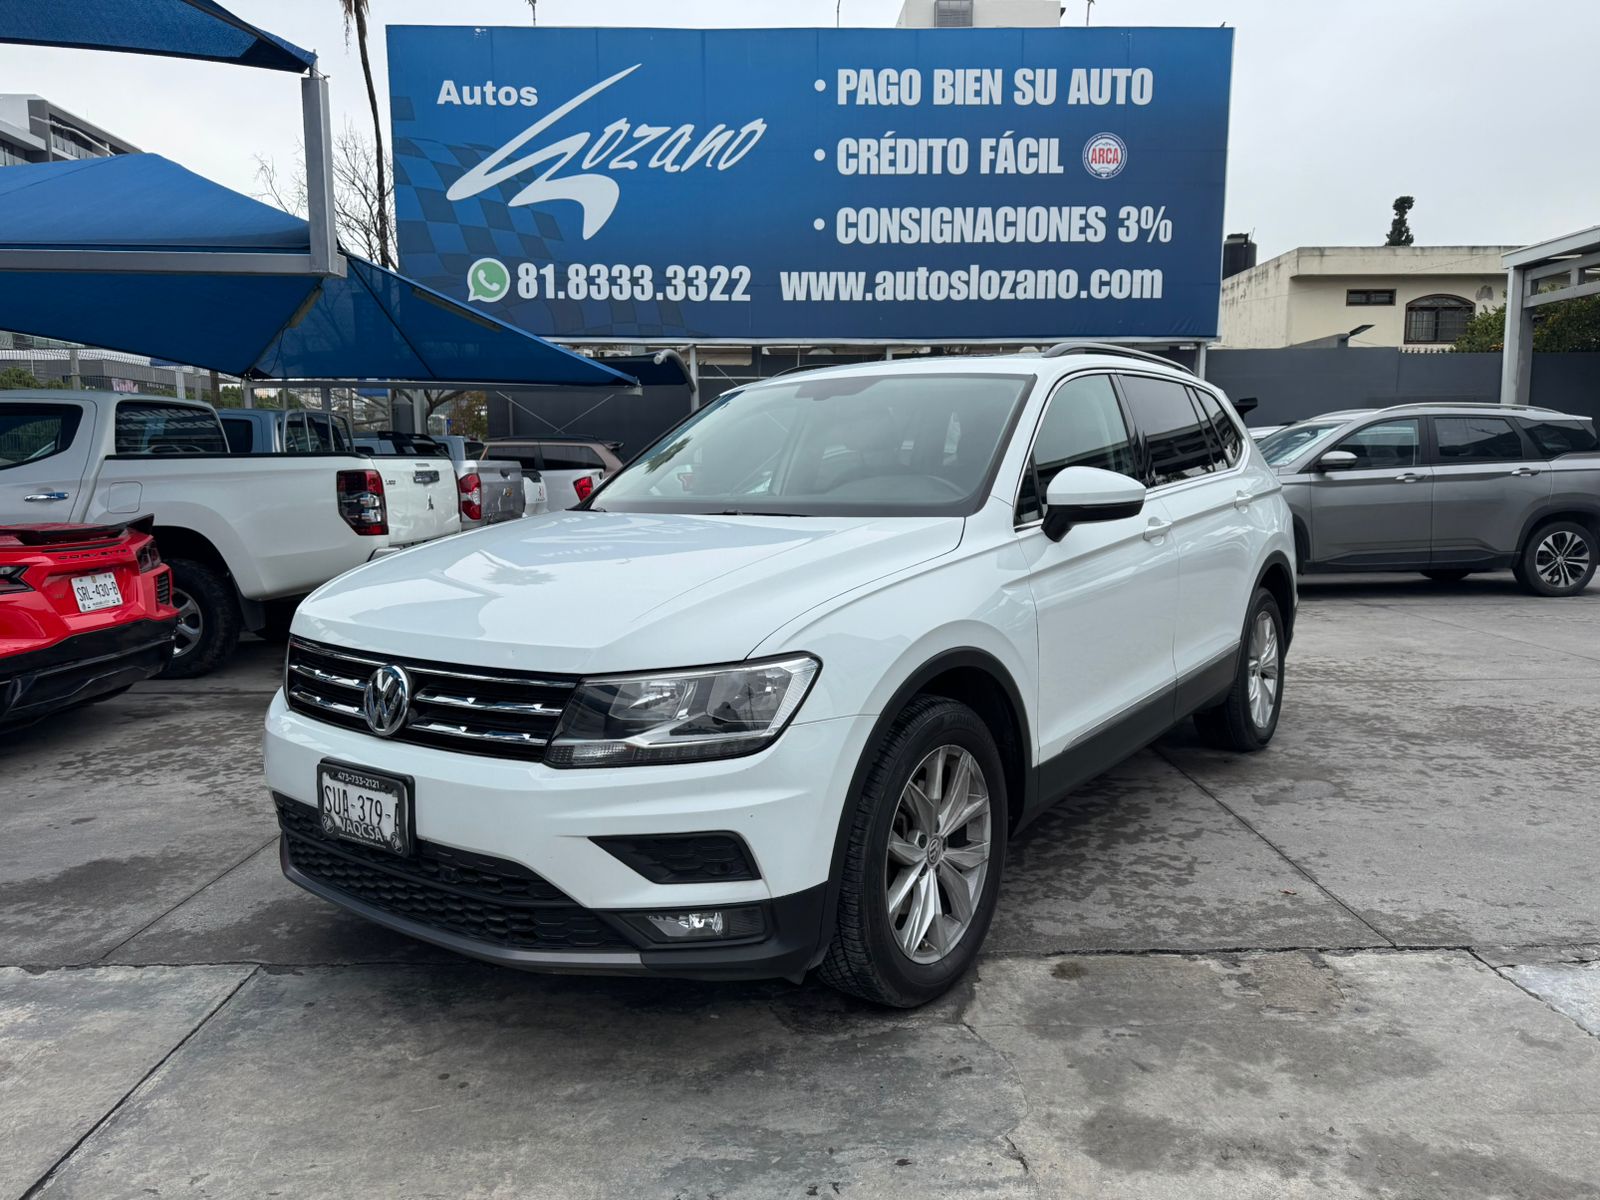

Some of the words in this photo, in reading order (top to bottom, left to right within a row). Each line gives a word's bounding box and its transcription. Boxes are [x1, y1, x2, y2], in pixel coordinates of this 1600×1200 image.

[436, 79, 539, 107] Autos
[837, 68, 922, 106] PAGO
[933, 68, 1003, 106] BIEN
[1013, 68, 1057, 106] SU
[1067, 67, 1154, 106] AUTO
[446, 63, 767, 240] Lozano
[837, 131, 969, 175] CRÉDITO
[980, 130, 1065, 175] FÁCIL
[1091, 147, 1119, 165] ARCA
[836, 206, 1107, 244] CONSIGNACIONES
[1117, 205, 1173, 243] 3%
[517, 262, 751, 302] 81.8333.3322
[780, 264, 1164, 302] www.autoslozano.com
[76, 581, 118, 602] SRL-430-B
[337, 770, 380, 789] 473-733-2121
[338, 815, 384, 843] VAQCSA
